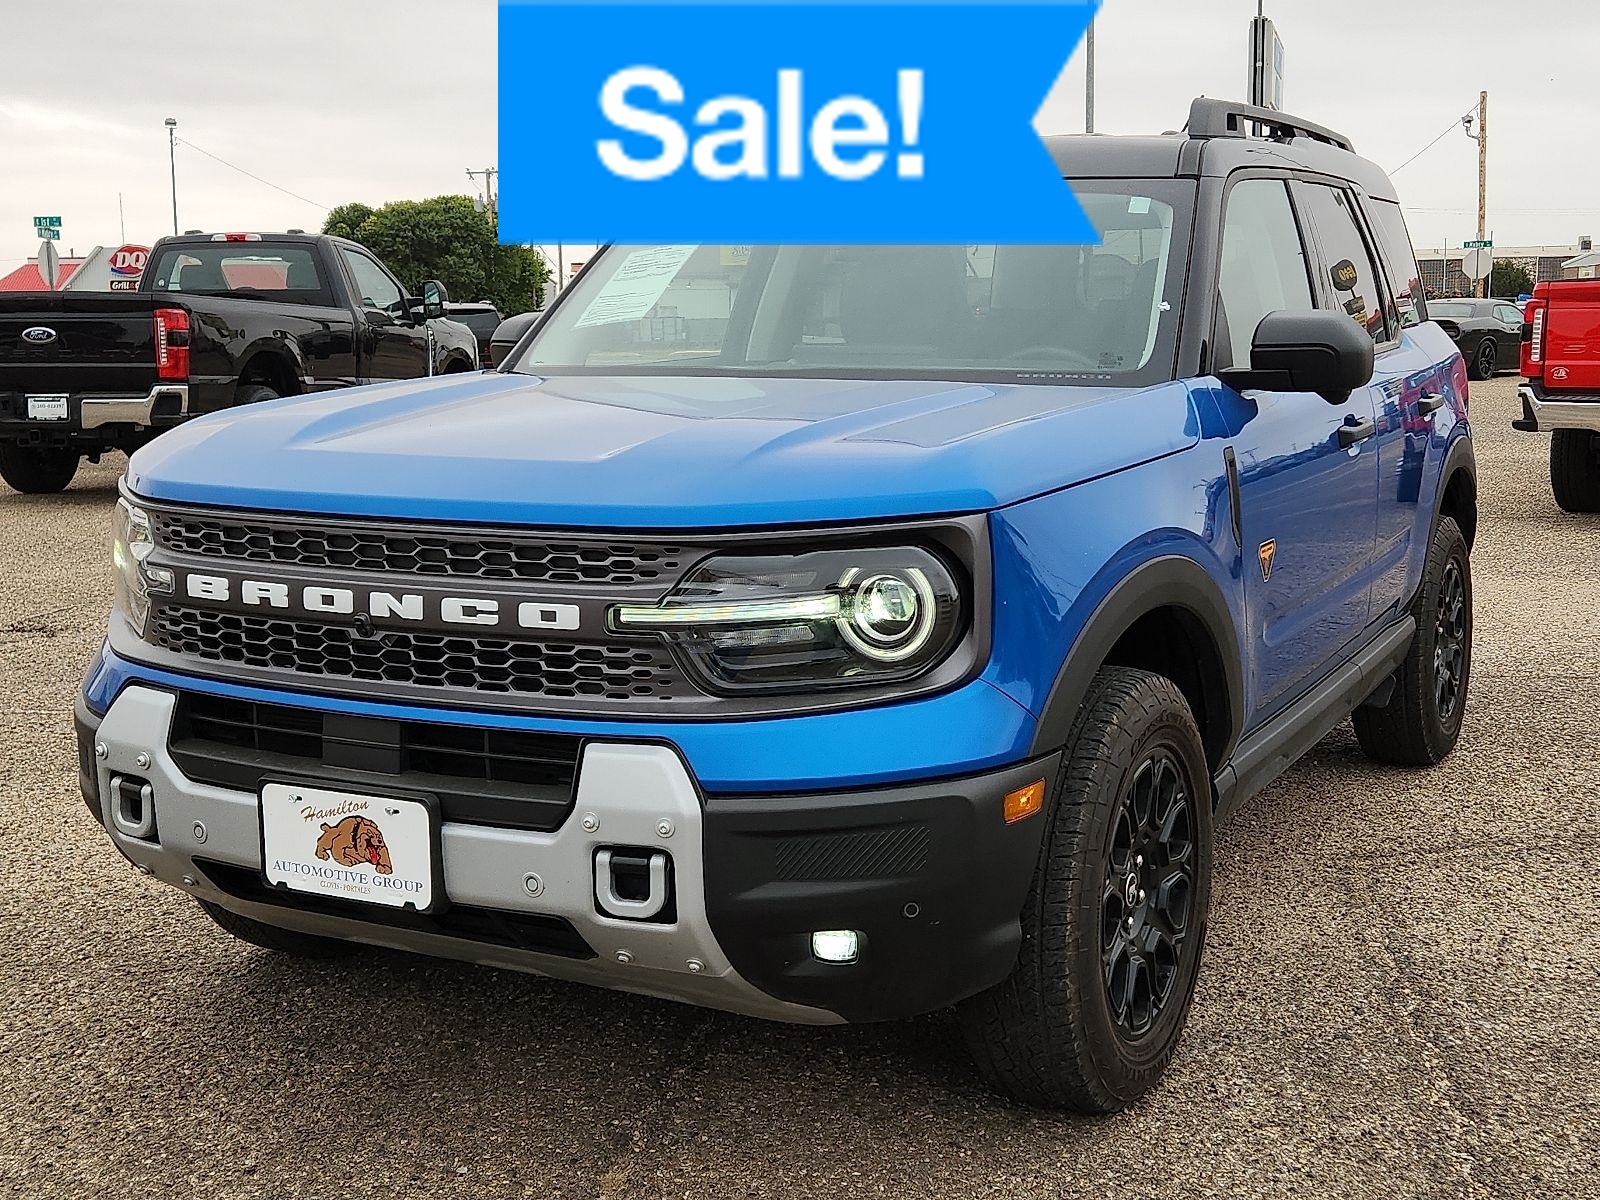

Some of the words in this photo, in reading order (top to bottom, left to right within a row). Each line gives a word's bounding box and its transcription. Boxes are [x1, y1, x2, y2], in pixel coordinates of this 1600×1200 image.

[115, 251, 146, 269] DQ
[111, 281, 129, 290] Grill
[29, 330, 48, 340] Ford
[186, 573, 581, 631] BRONCO
[300, 799, 370, 823] Hamilton
[273, 859, 369, 885] AUTOMOTIVE
[372, 875, 424, 893] GROUP
